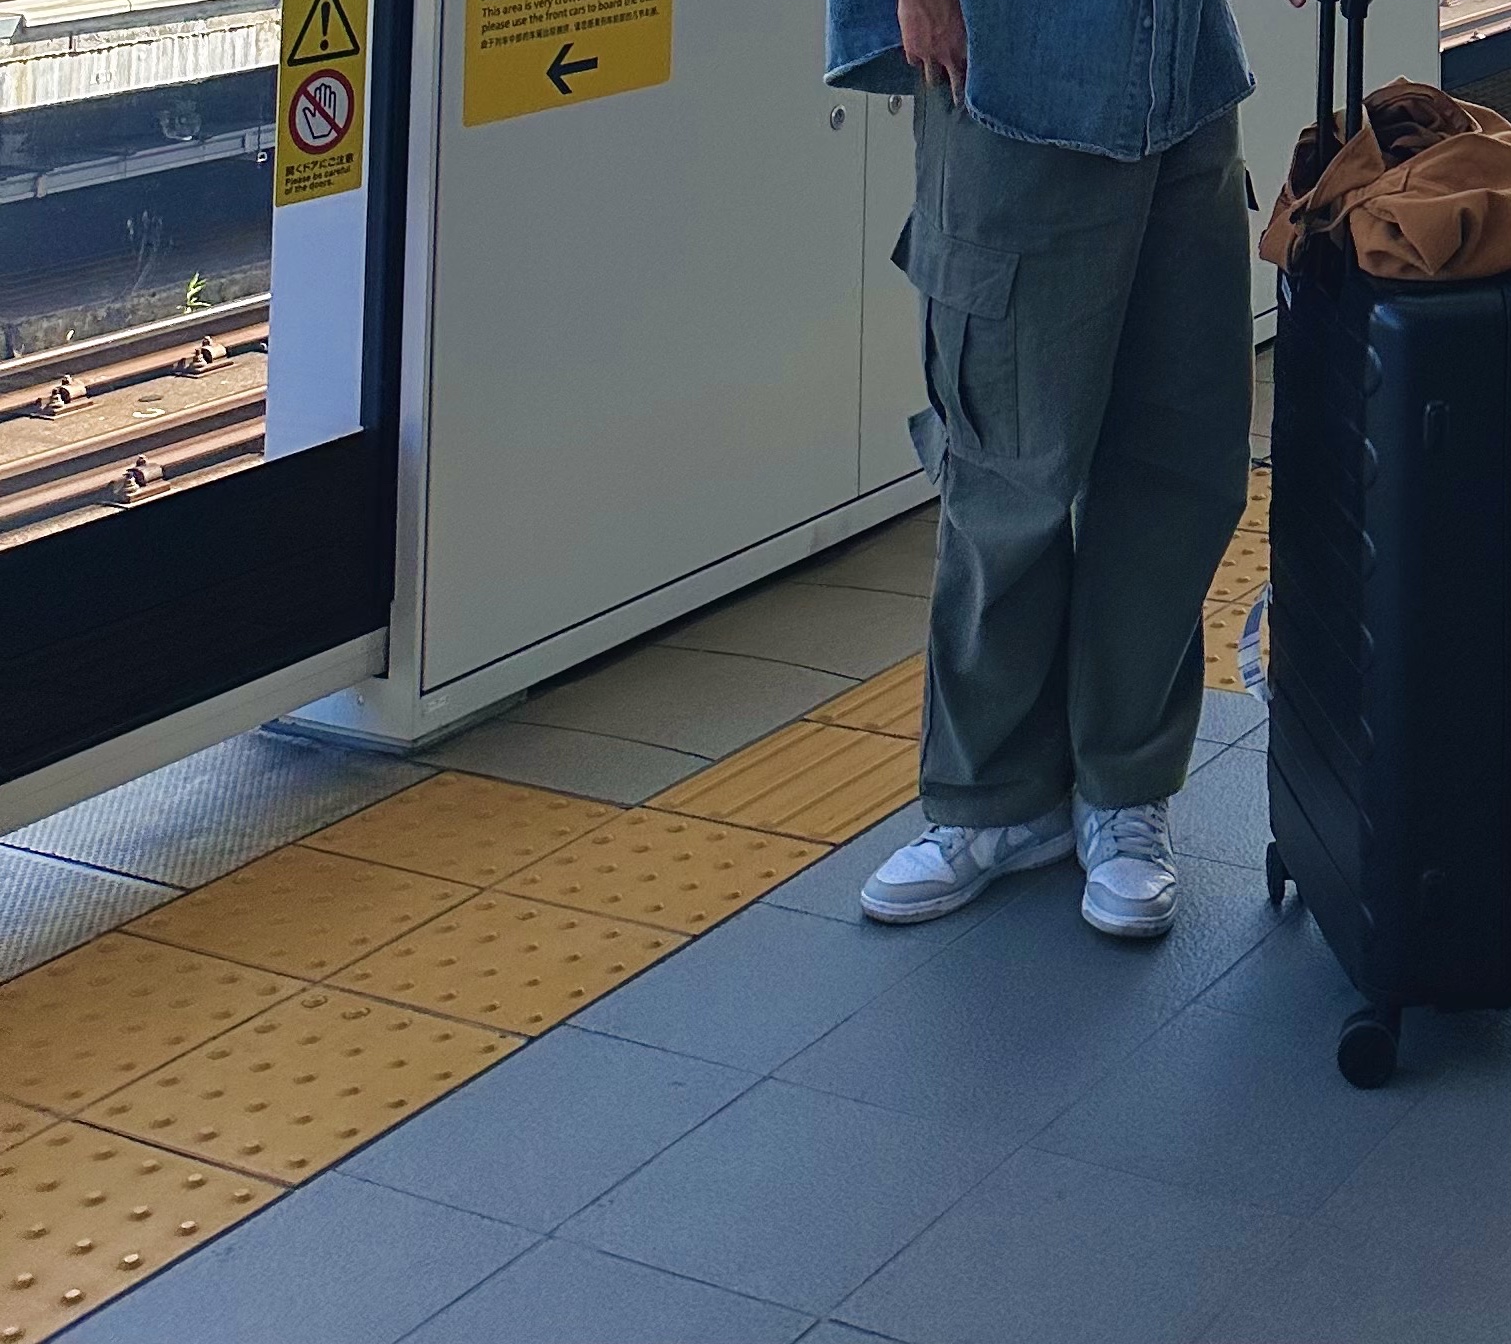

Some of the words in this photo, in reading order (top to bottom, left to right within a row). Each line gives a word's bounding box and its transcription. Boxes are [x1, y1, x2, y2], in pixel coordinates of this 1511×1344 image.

[481, 19, 511, 35] please
[512, 16, 527, 27] use
[529, 12, 543, 24] the
[545, 7, 568, 21] front
[569, 5, 586, 17] cars
[587, 3, 597, 14] to
[482, 6, 501, 18] This
[502, 2, 523, 14] area
[524, 0, 532, 9] is
